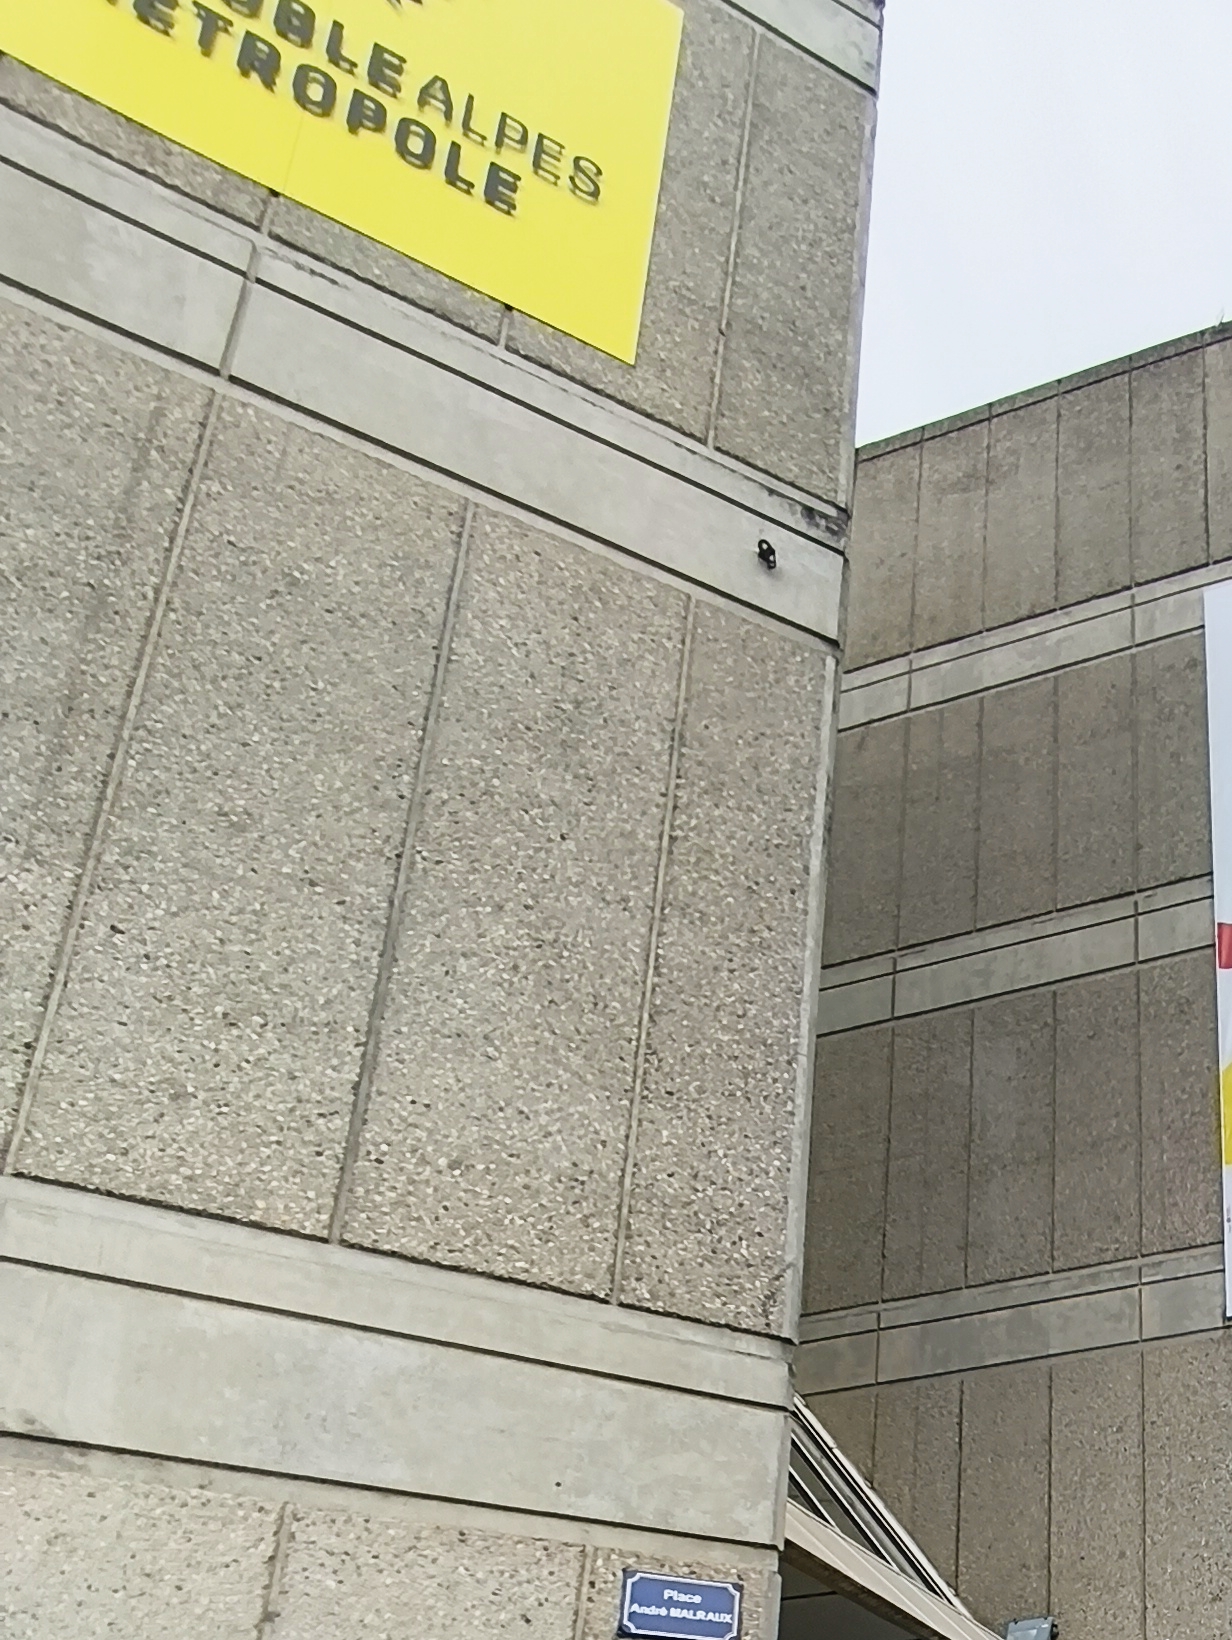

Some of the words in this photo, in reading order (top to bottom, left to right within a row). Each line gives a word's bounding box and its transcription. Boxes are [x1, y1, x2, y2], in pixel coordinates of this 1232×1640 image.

[663, 1589, 703, 1604] Place
[629, 1603, 668, 1617] André
[669, 1607, 733, 1624] MALRAUX
